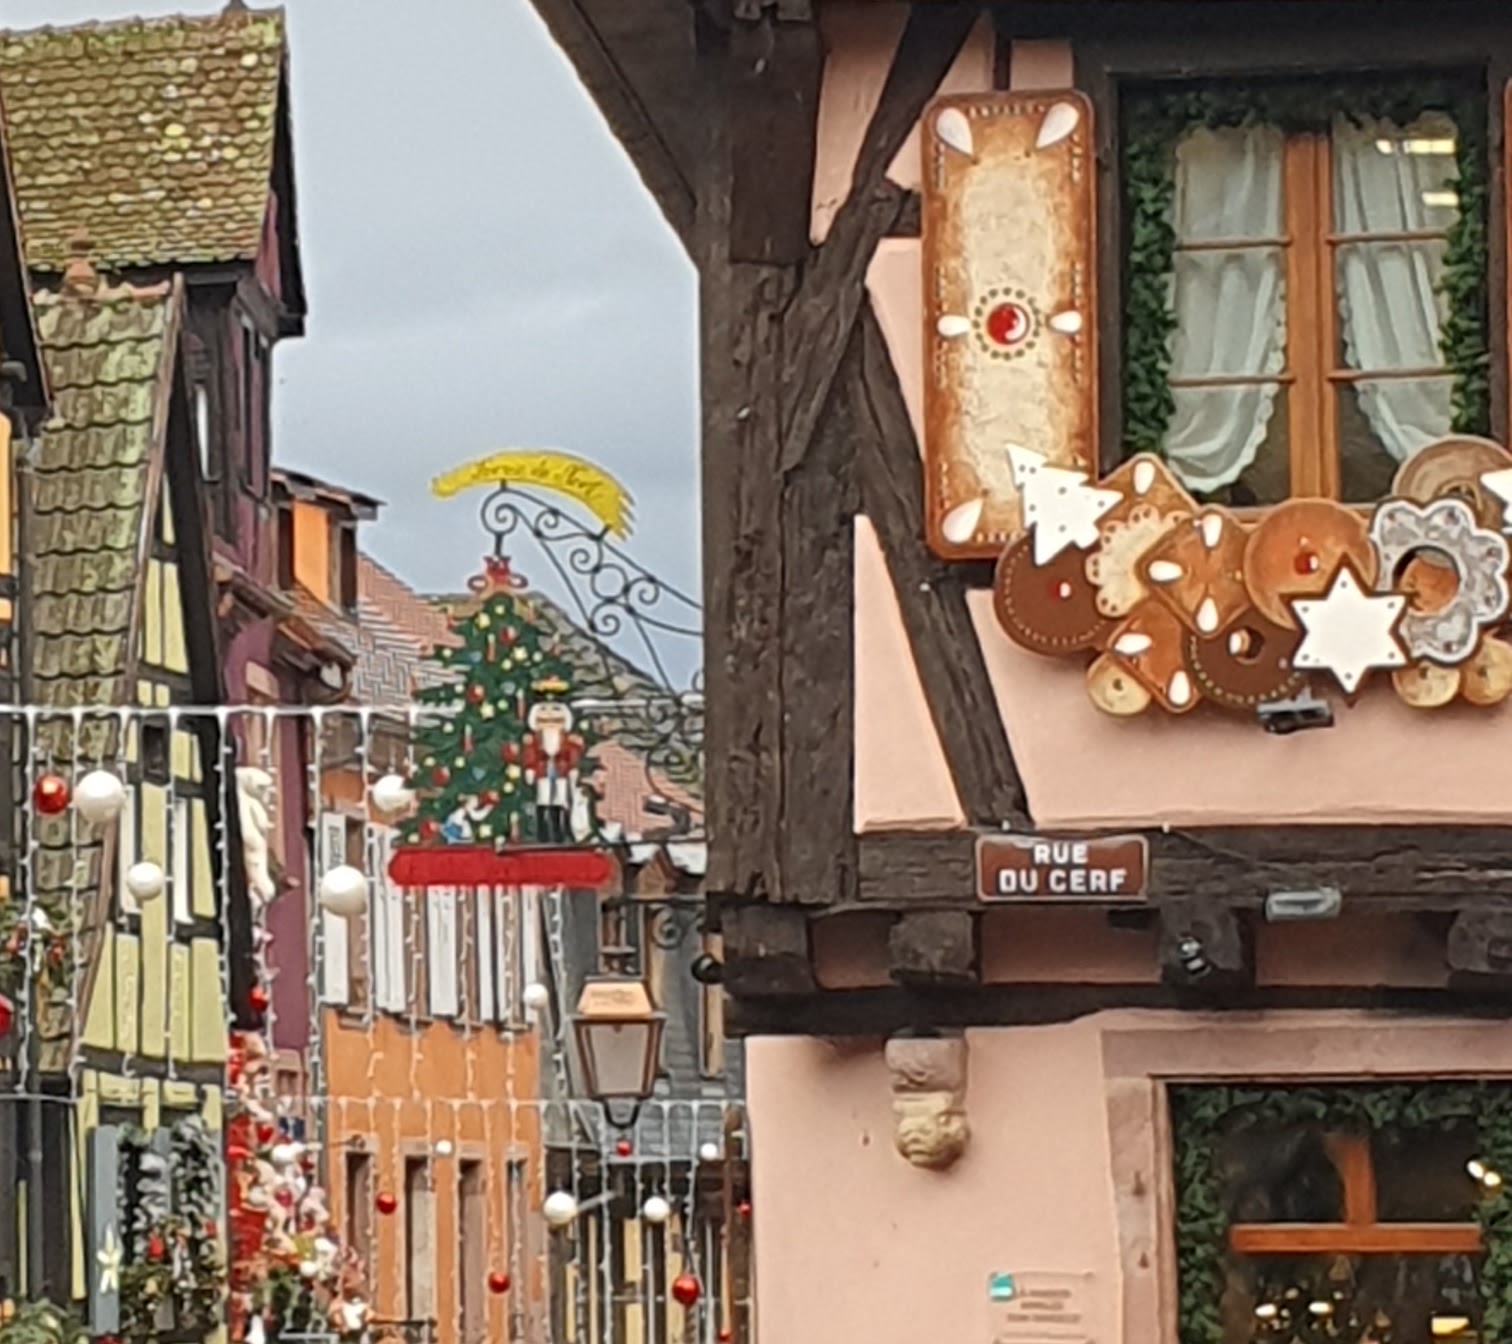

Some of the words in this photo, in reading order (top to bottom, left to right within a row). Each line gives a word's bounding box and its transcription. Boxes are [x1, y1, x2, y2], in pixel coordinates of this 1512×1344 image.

[1033, 842, 1089, 864] RUE
[998, 868, 1039, 893] DU
[1048, 868, 1128, 893] CERF
